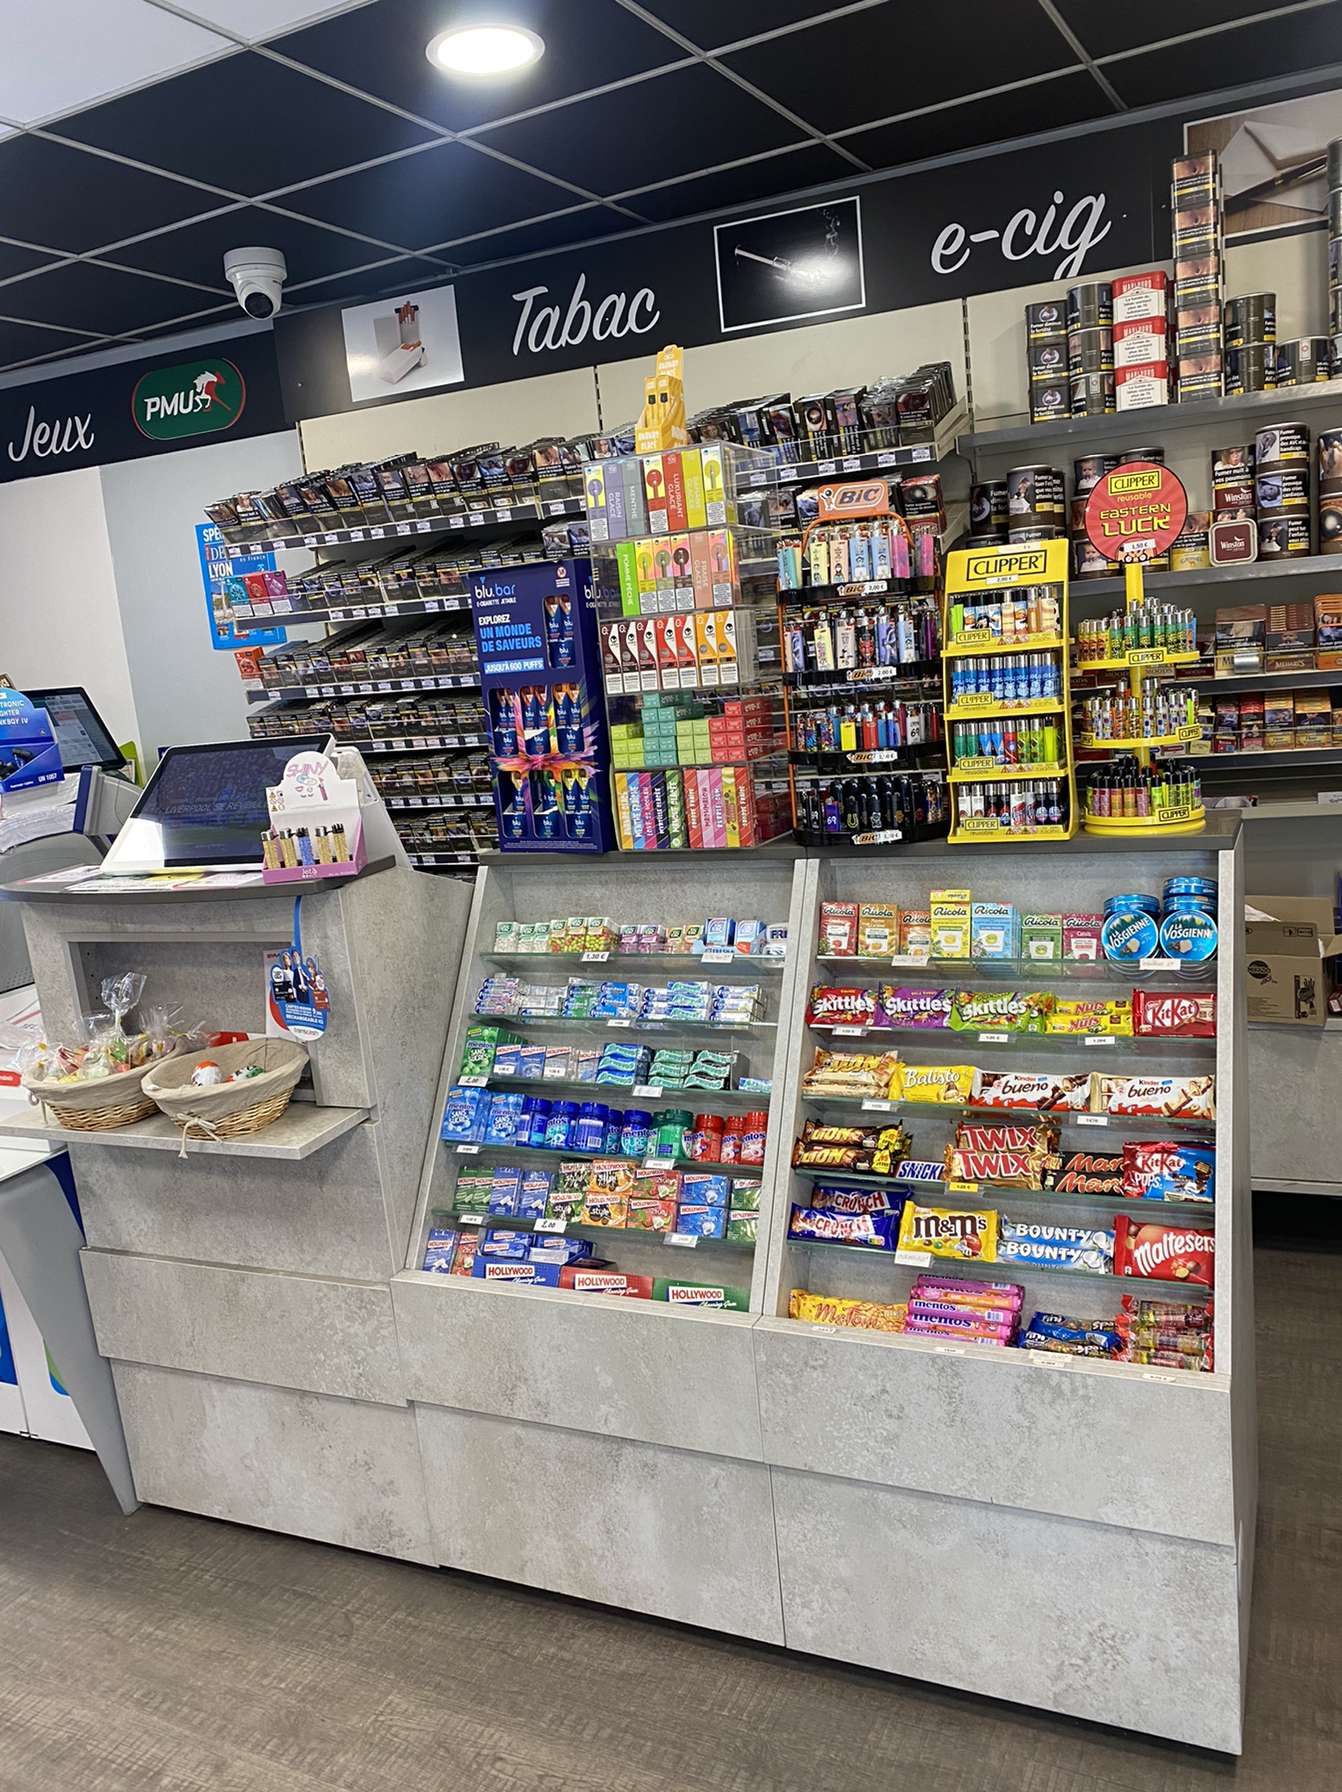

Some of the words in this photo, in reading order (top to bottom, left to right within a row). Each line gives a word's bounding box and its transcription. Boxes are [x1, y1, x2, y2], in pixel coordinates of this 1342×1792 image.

[930, 190, 1112, 281] e-cig
[511, 272, 660, 357] Tabac
[143, 389, 196, 422] PMU
[8, 406, 95, 463] Jeux
[1113, 473, 1155, 491] CLIPPER
[1101, 514, 1171, 537] LUCK
[208, 561, 233, 578] LYON
[973, 554, 1039, 576] CLIPPER
[480, 626, 494, 639] UN
[495, 623, 532, 638] MONDE
[958, 632, 988, 642] CLIPPER
[481, 641, 495, 653] DE
[496, 636, 543, 652] SAVEURS
[1131, 652, 1163, 663] CLIPPER
[960, 695, 991, 705] CLIPPER
[962, 758, 992, 769] CLIPPER
[1161, 808, 1189, 821] CLIPPER
[966, 819, 998, 831] CLIPPER
[824, 906, 855, 917] Ricola
[862, 907, 893, 918] Ricola
[933, 907, 968, 917] Ricola
[974, 905, 1009, 916] Ricola
[1024, 916, 1059, 927] Ricola
[1066, 918, 1100, 928] Ricola
[1107, 916, 1150, 953] VOSGIENNE
[1151, 1000, 1197, 1027] KitKat
[1069, 1016, 1100, 1031] Nuts
[903, 1067, 960, 1088] Balisto
[1002, 1080, 1049, 1095] bueno
[1127, 1085, 1171, 1099] bueno
[811, 1127, 850, 1142] LION
[963, 1125, 1040, 1151] TWIX
[801, 1148, 845, 1164] LION
[953, 1148, 1034, 1180] TWIX
[899, 1161, 944, 1180] SNICK
[1015, 1223, 1092, 1243] BOUNTY
[1006, 1241, 1084, 1261] BOUNTY
[1133, 1231, 1215, 1277] Maltesers
[488, 1265, 533, 1277] HOLLYWOOD
[577, 1276, 625, 1287] HOLLYWOOD
[671, 1288, 723, 1300] HOLLYWOOD
[914, 1300, 957, 1312] mentos
[912, 1312, 972, 1328] mentos
